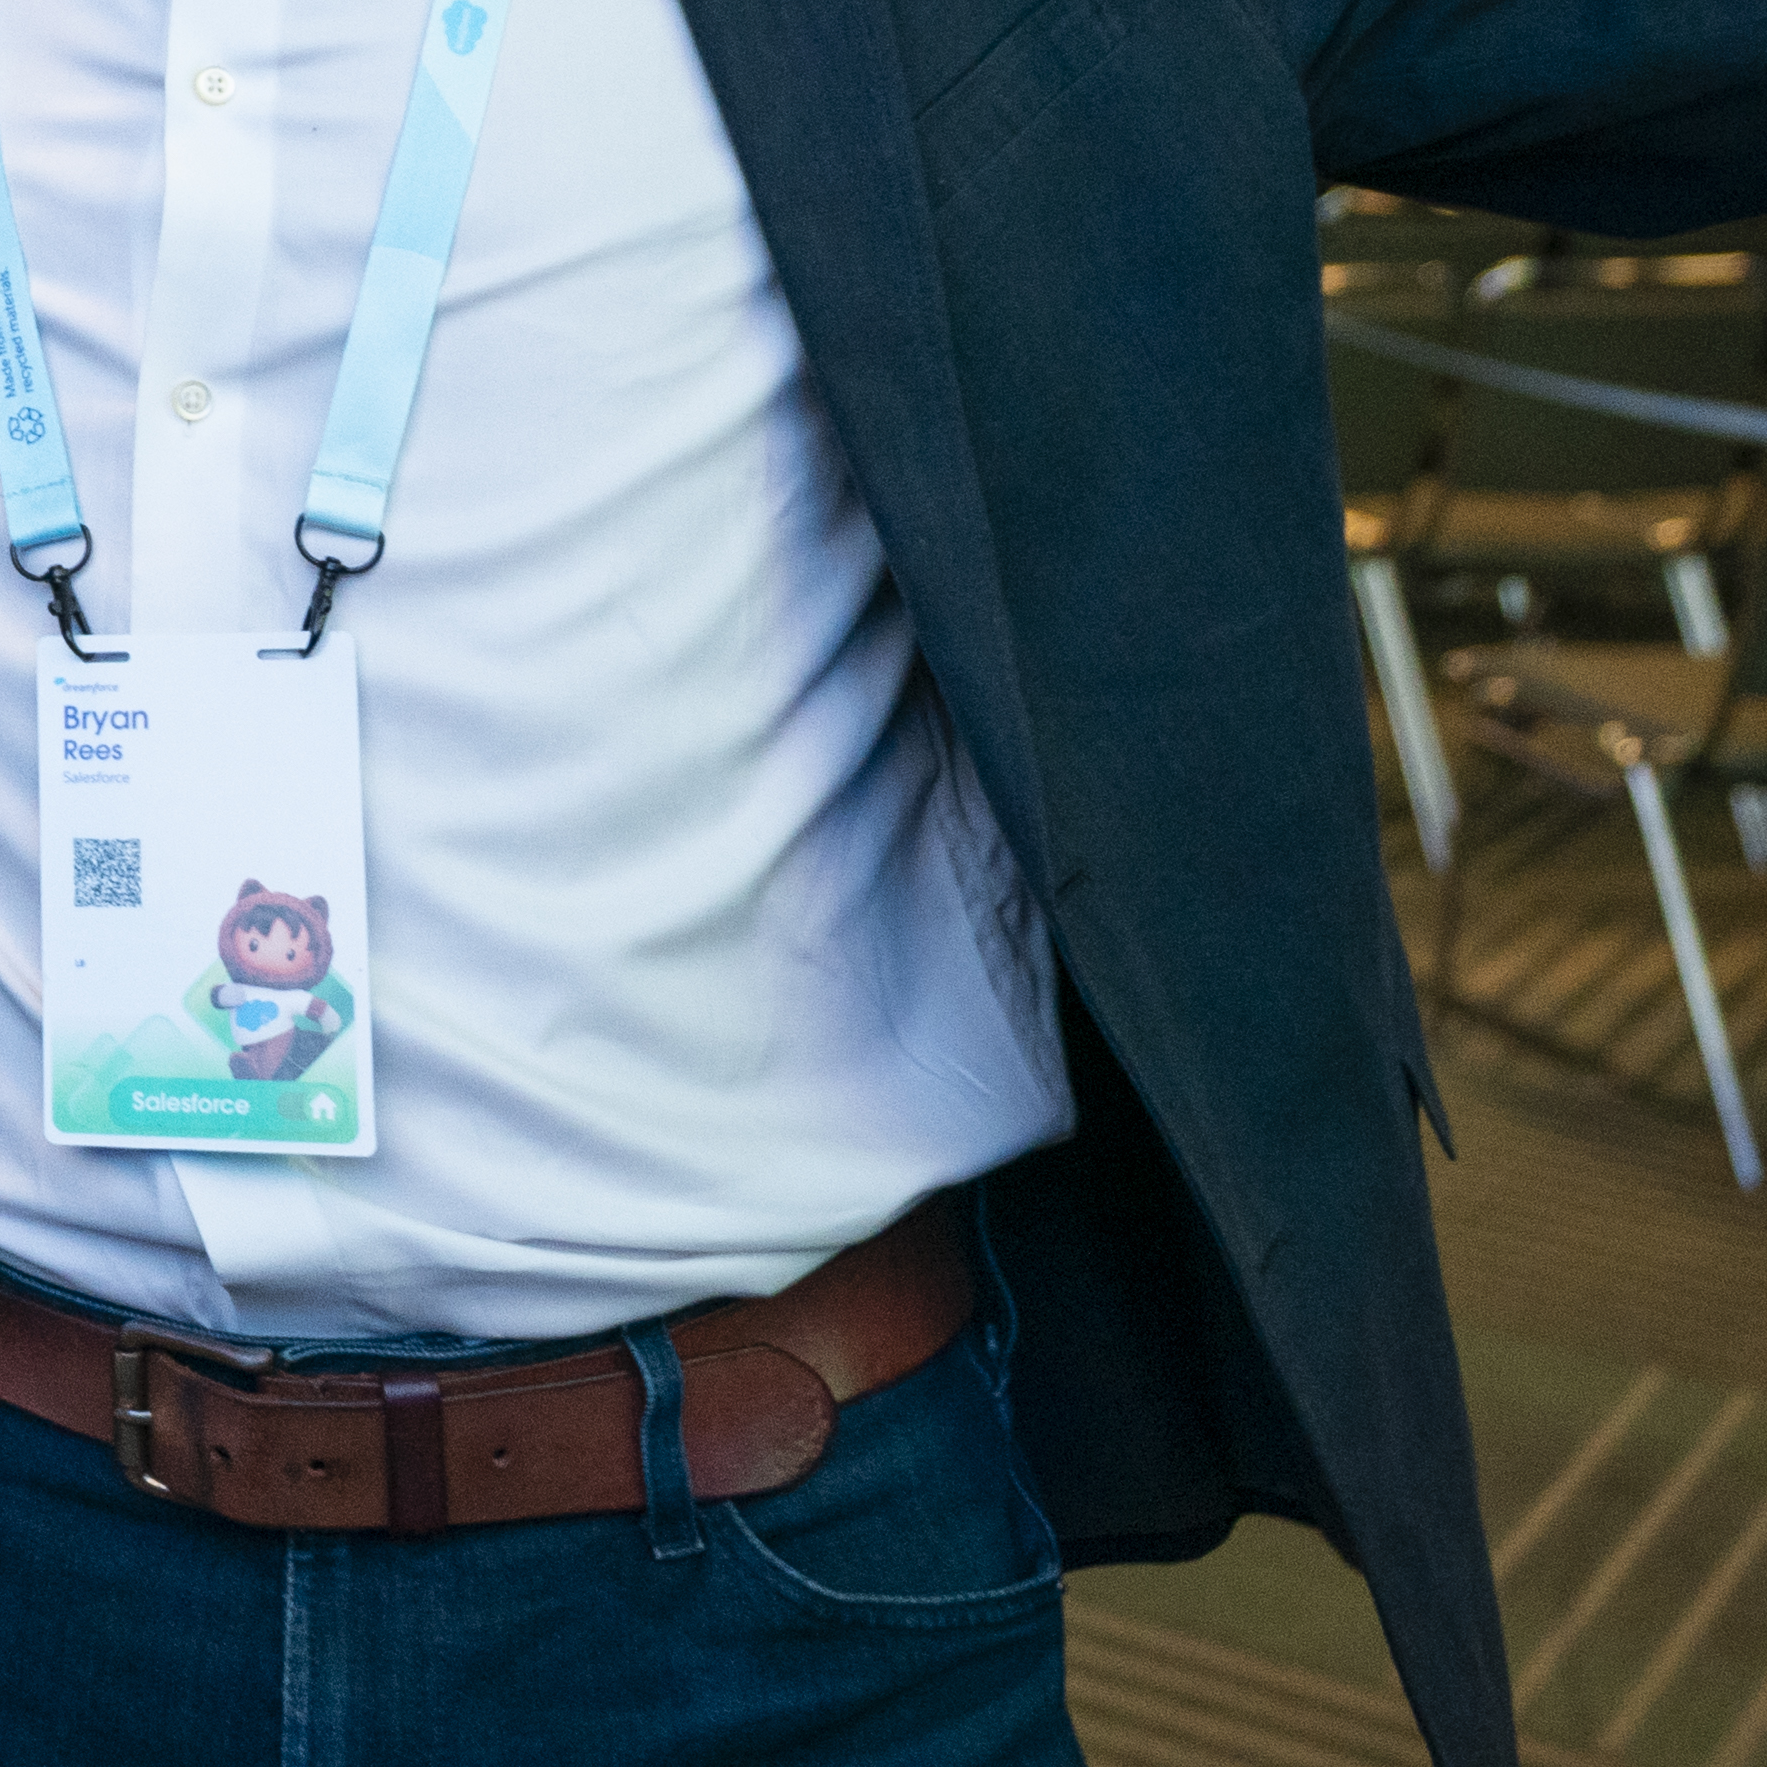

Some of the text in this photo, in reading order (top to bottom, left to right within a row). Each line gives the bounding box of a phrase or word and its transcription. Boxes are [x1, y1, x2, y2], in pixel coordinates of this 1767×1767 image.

[2, 358, 17, 399] Made
[11, 335, 34, 394] recycled
[64, 704, 149, 736] Bryan
[64, 739, 123, 761] Rees
[63, 771, 130, 784] Salesforce
[131, 1090, 251, 1116] Salesforce
